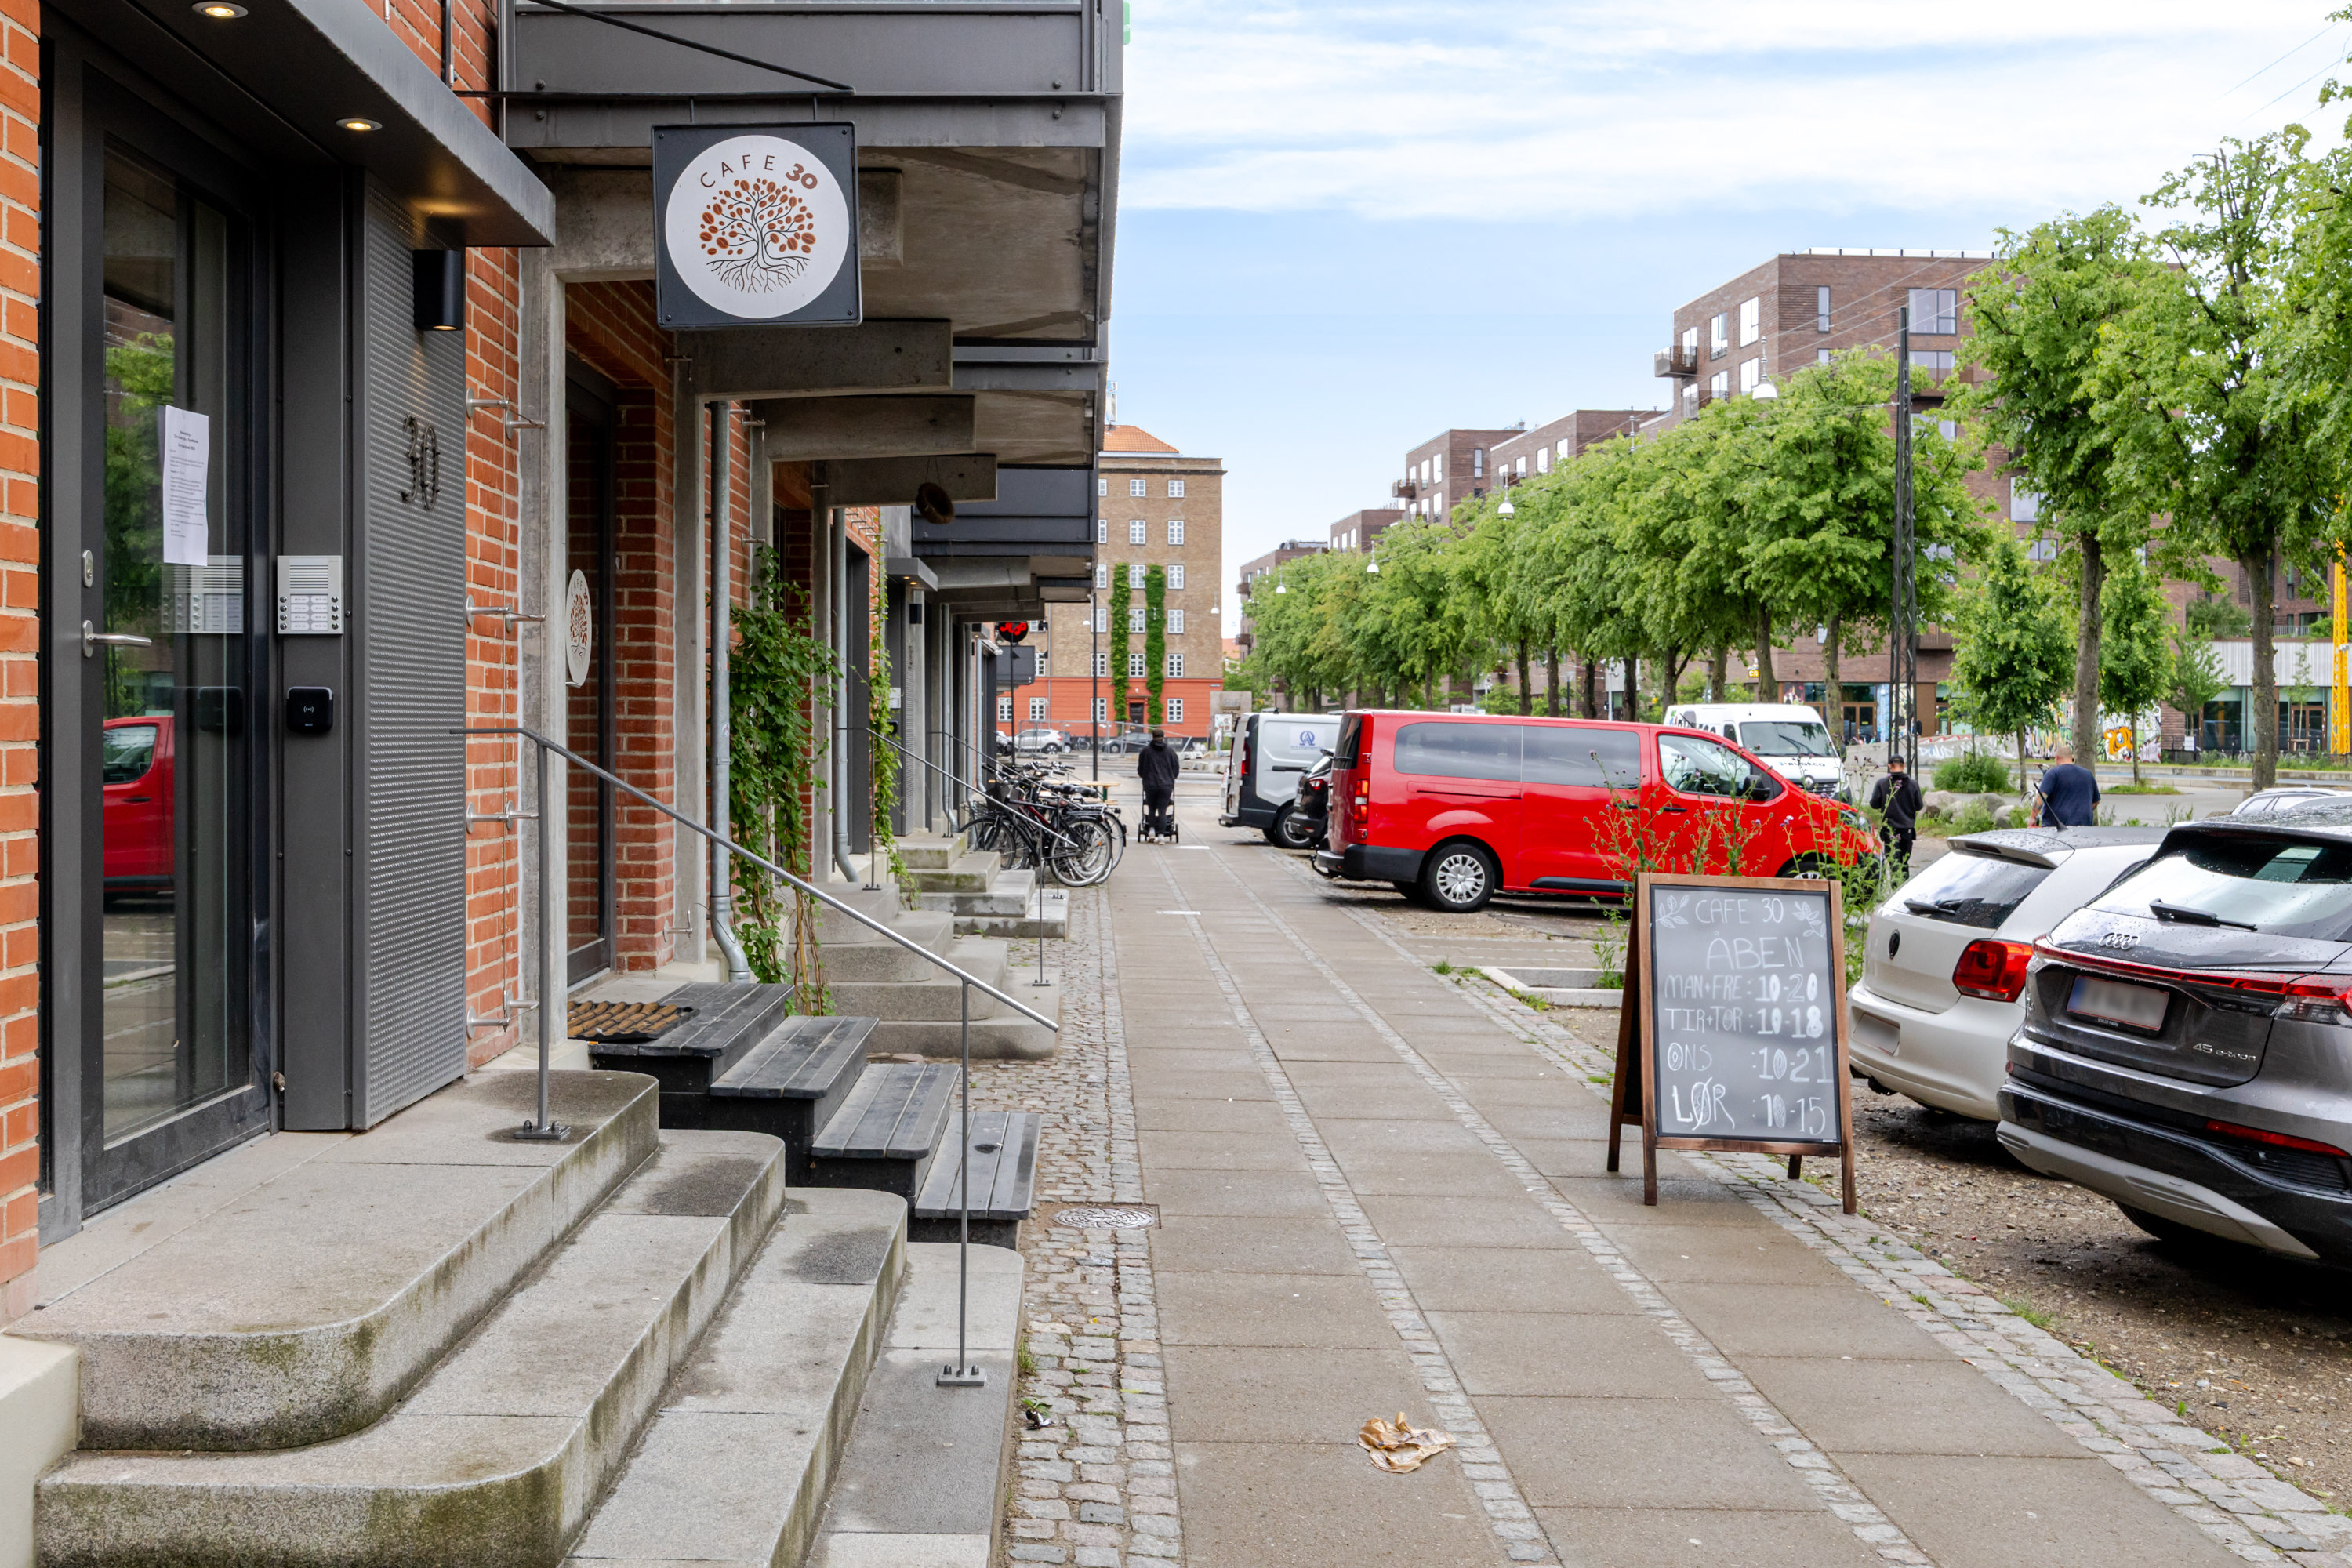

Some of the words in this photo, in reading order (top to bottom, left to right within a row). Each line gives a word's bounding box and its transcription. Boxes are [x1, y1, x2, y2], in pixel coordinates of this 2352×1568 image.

[700, 154, 775, 188] CAFE
[786, 163, 818, 190] 30
[402, 416, 440, 510] 30
[1695, 898, 1750, 924] CAFE
[1762, 898, 1784, 923] 30
[1707, 931, 1805, 971] ÅBEN
[1668, 1042, 1713, 1072] ONS
[2192, 1043, 2213, 1054] 45
[2216, 1050, 2256, 1061] e-tron
[1672, 1076, 1735, 1131] LØR
